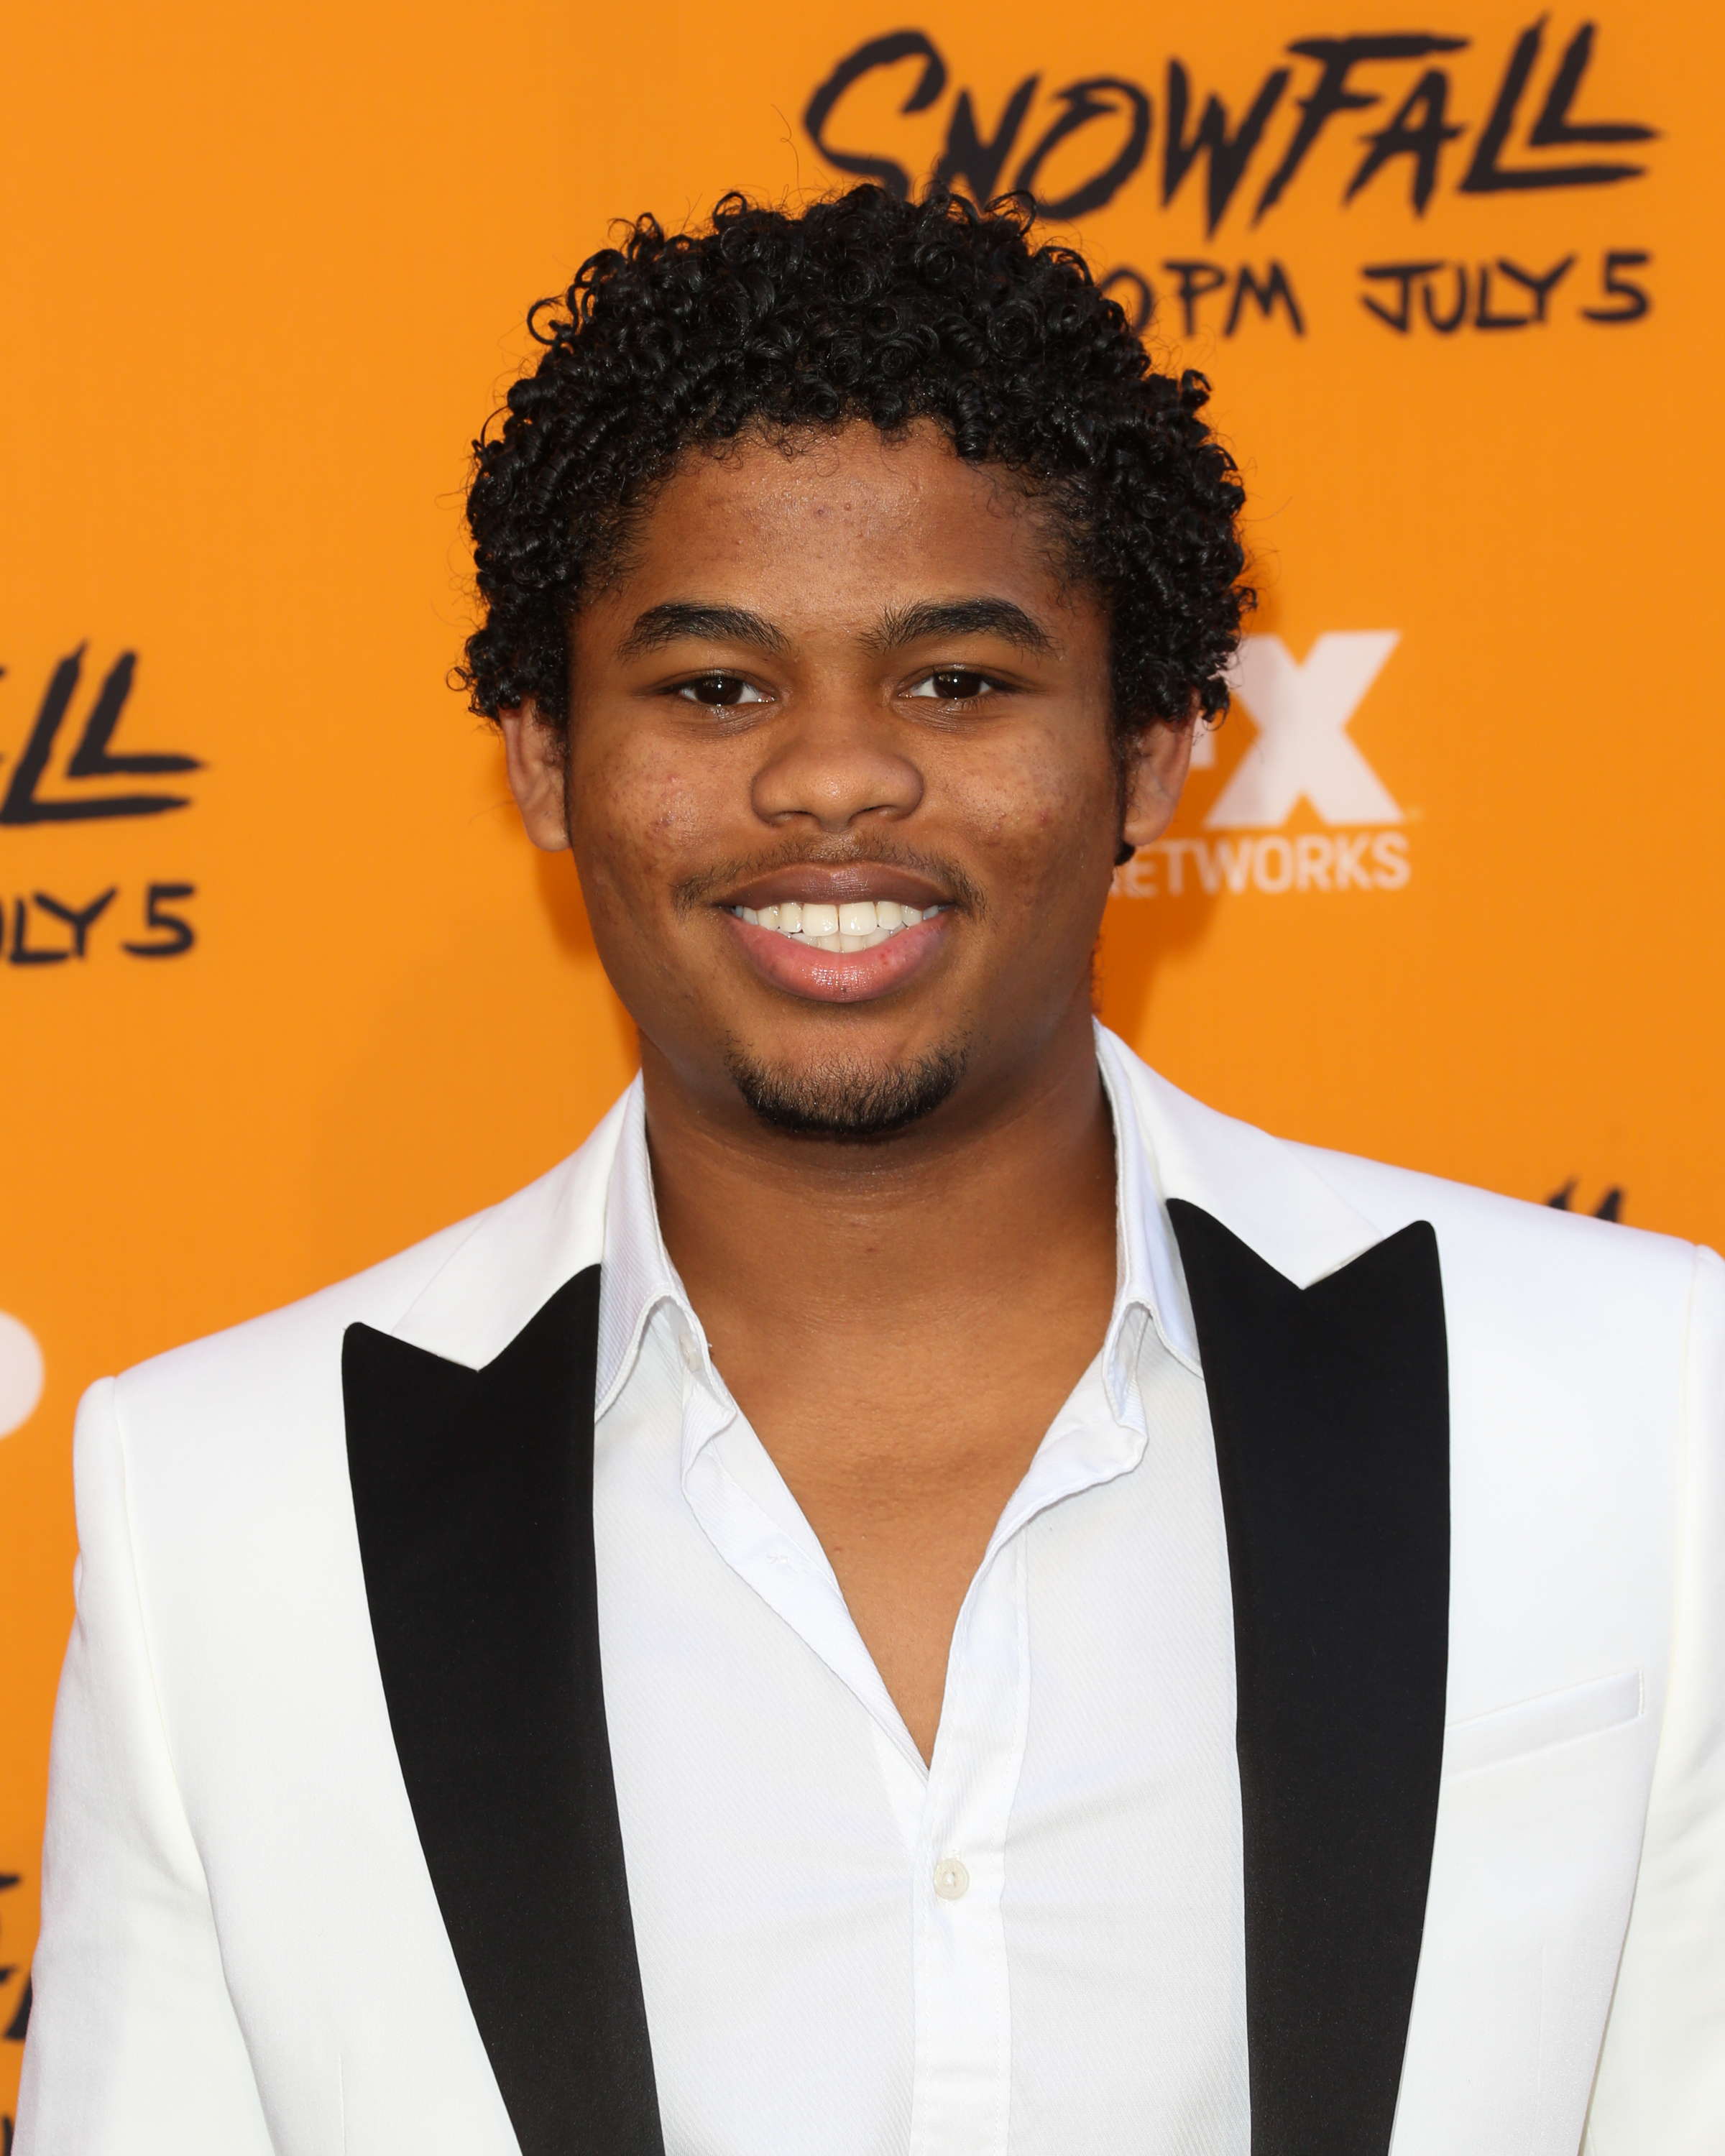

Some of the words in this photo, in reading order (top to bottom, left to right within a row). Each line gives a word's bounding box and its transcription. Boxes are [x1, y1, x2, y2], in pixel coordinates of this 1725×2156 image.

[801, 10, 1662, 242] SNOWFALL
[1360, 254, 1574, 333] JULY
[1581, 251, 1650, 322] 5
[0, 640, 205, 825] LL
[1190, 630, 1402, 829] X
[0, 884, 117, 964] LY
[122, 883, 196, 957] 5
[1108, 833, 1410, 897] ETWORKS
